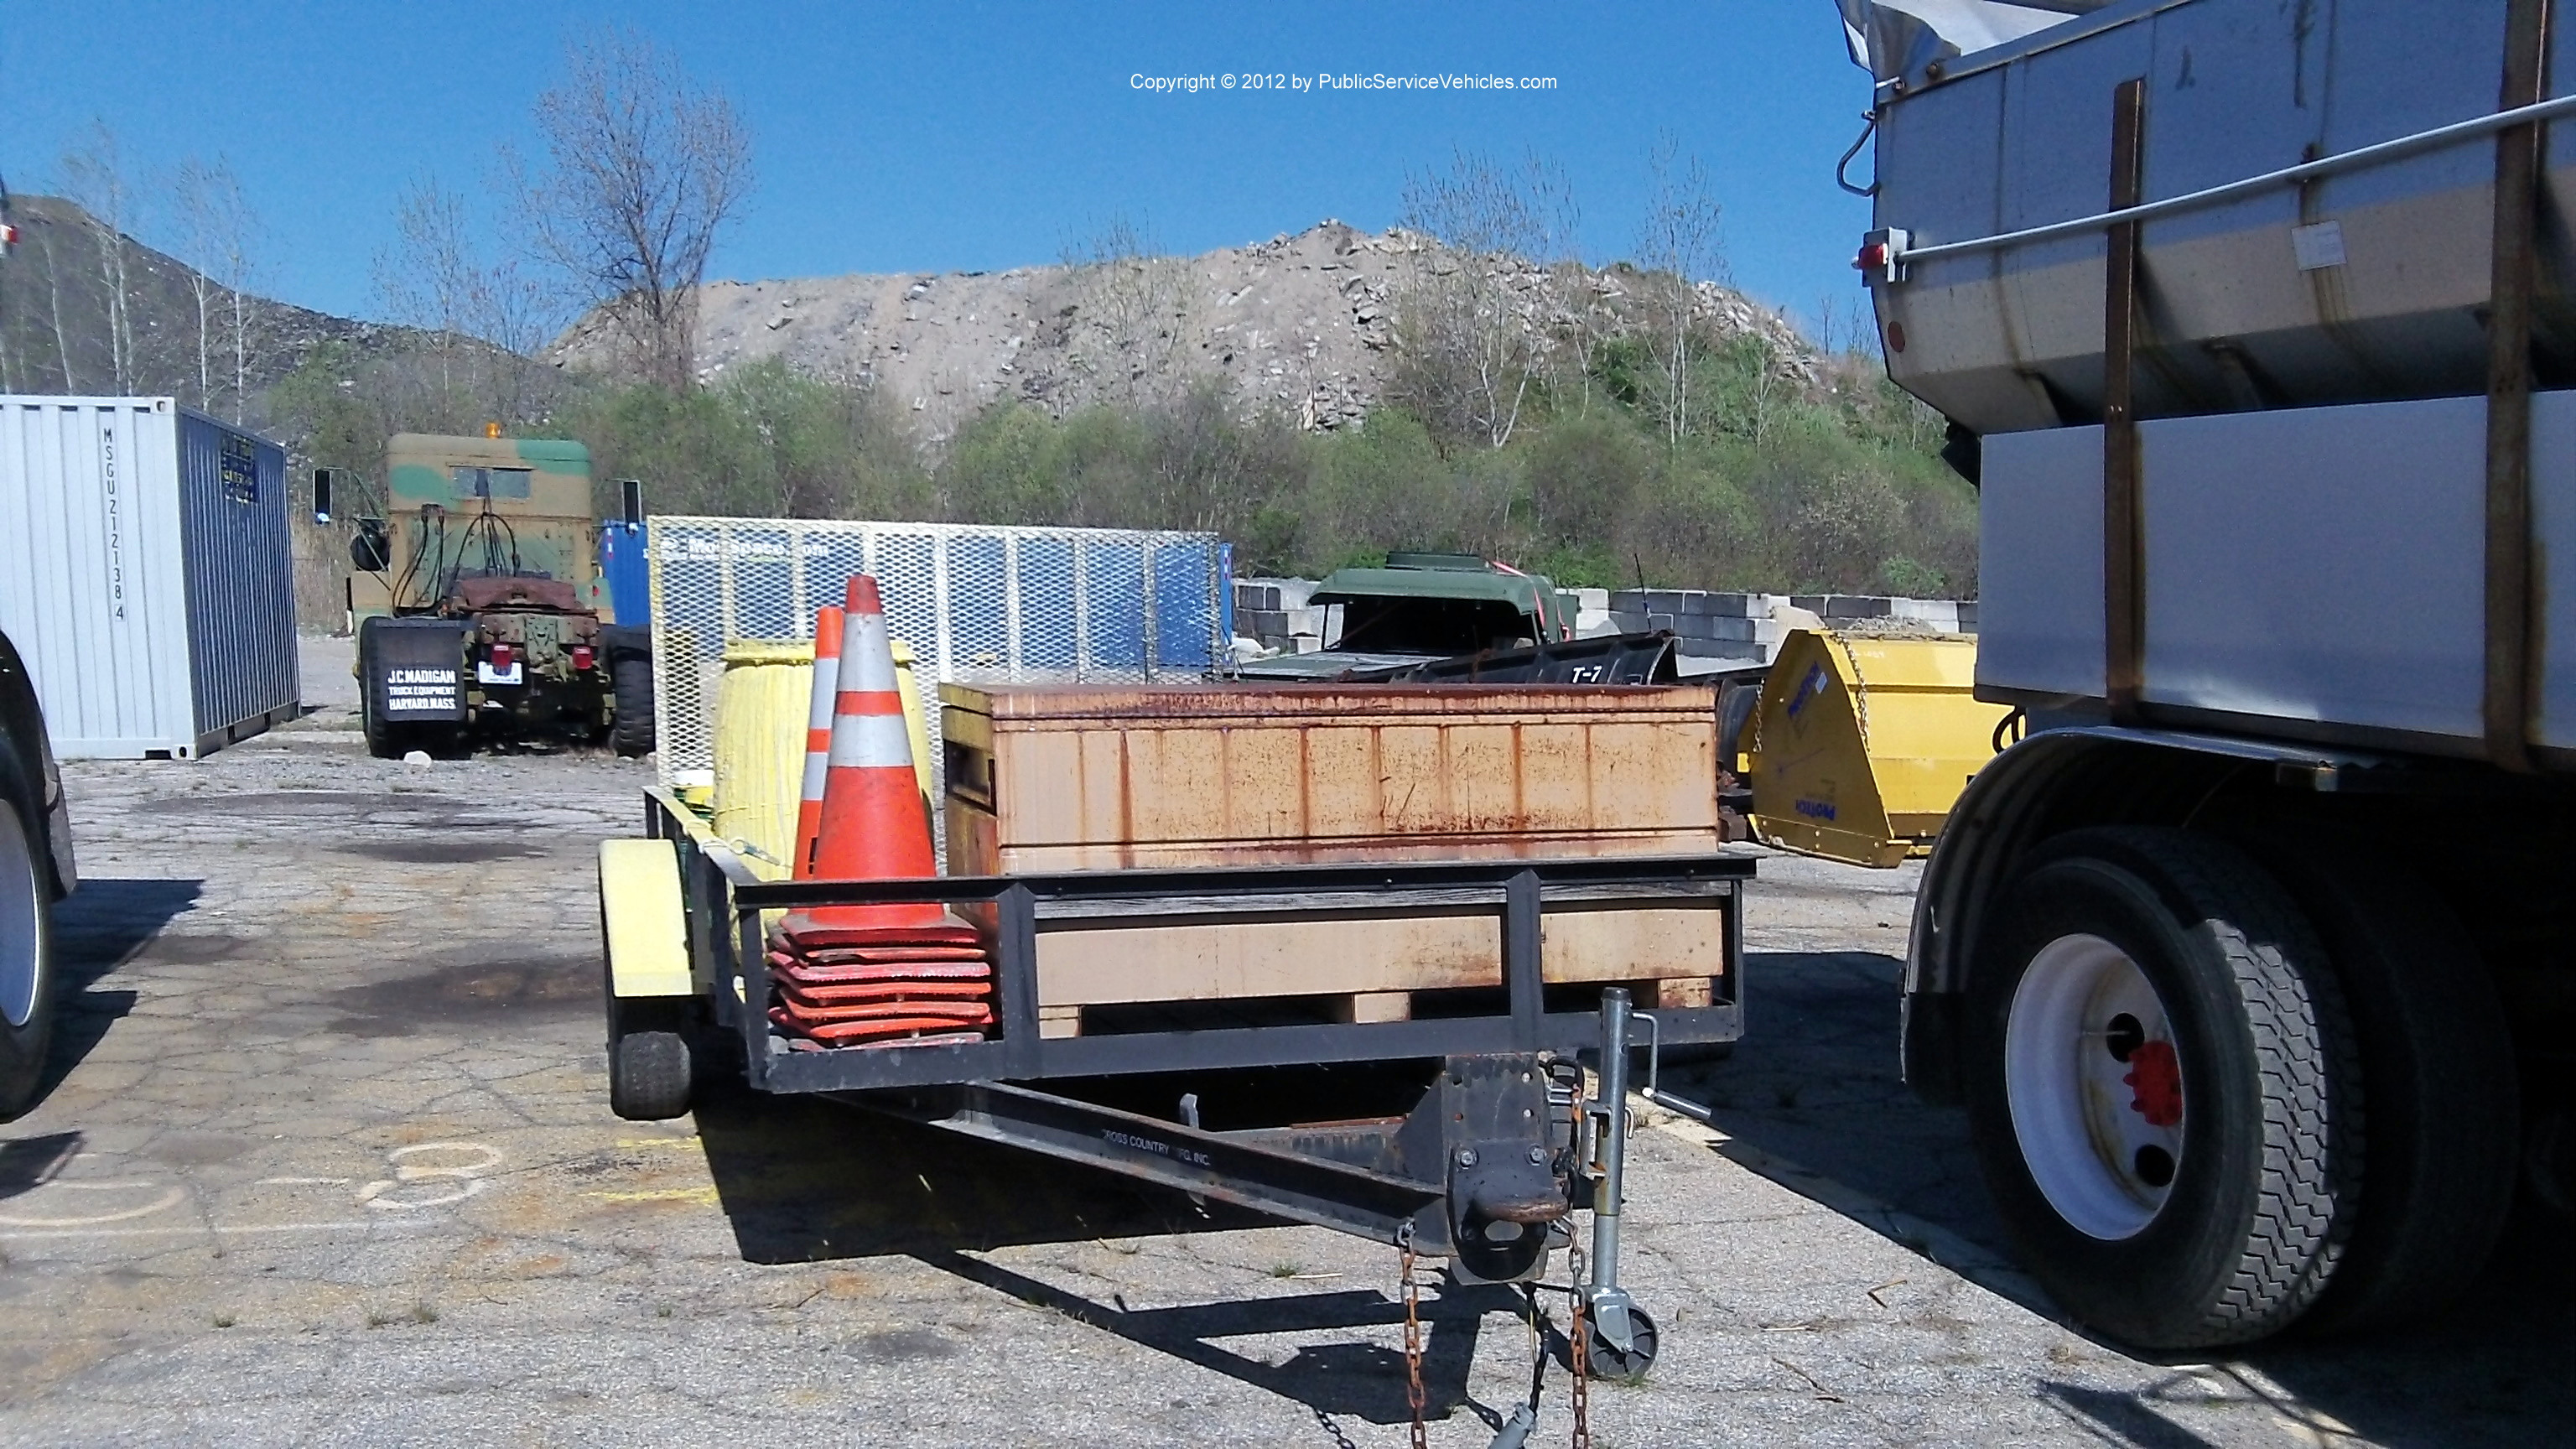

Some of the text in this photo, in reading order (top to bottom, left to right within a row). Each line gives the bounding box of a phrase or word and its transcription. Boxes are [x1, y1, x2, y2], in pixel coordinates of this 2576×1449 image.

[404, 669, 456, 683] MADIGAN
[1572, 665, 1603, 684] T-7
[388, 686, 456, 696] TRUCK EQUIPMENT
[1130, 1135, 1170, 1156] COUNTRY
[1193, 1151, 1211, 1166] INC.
